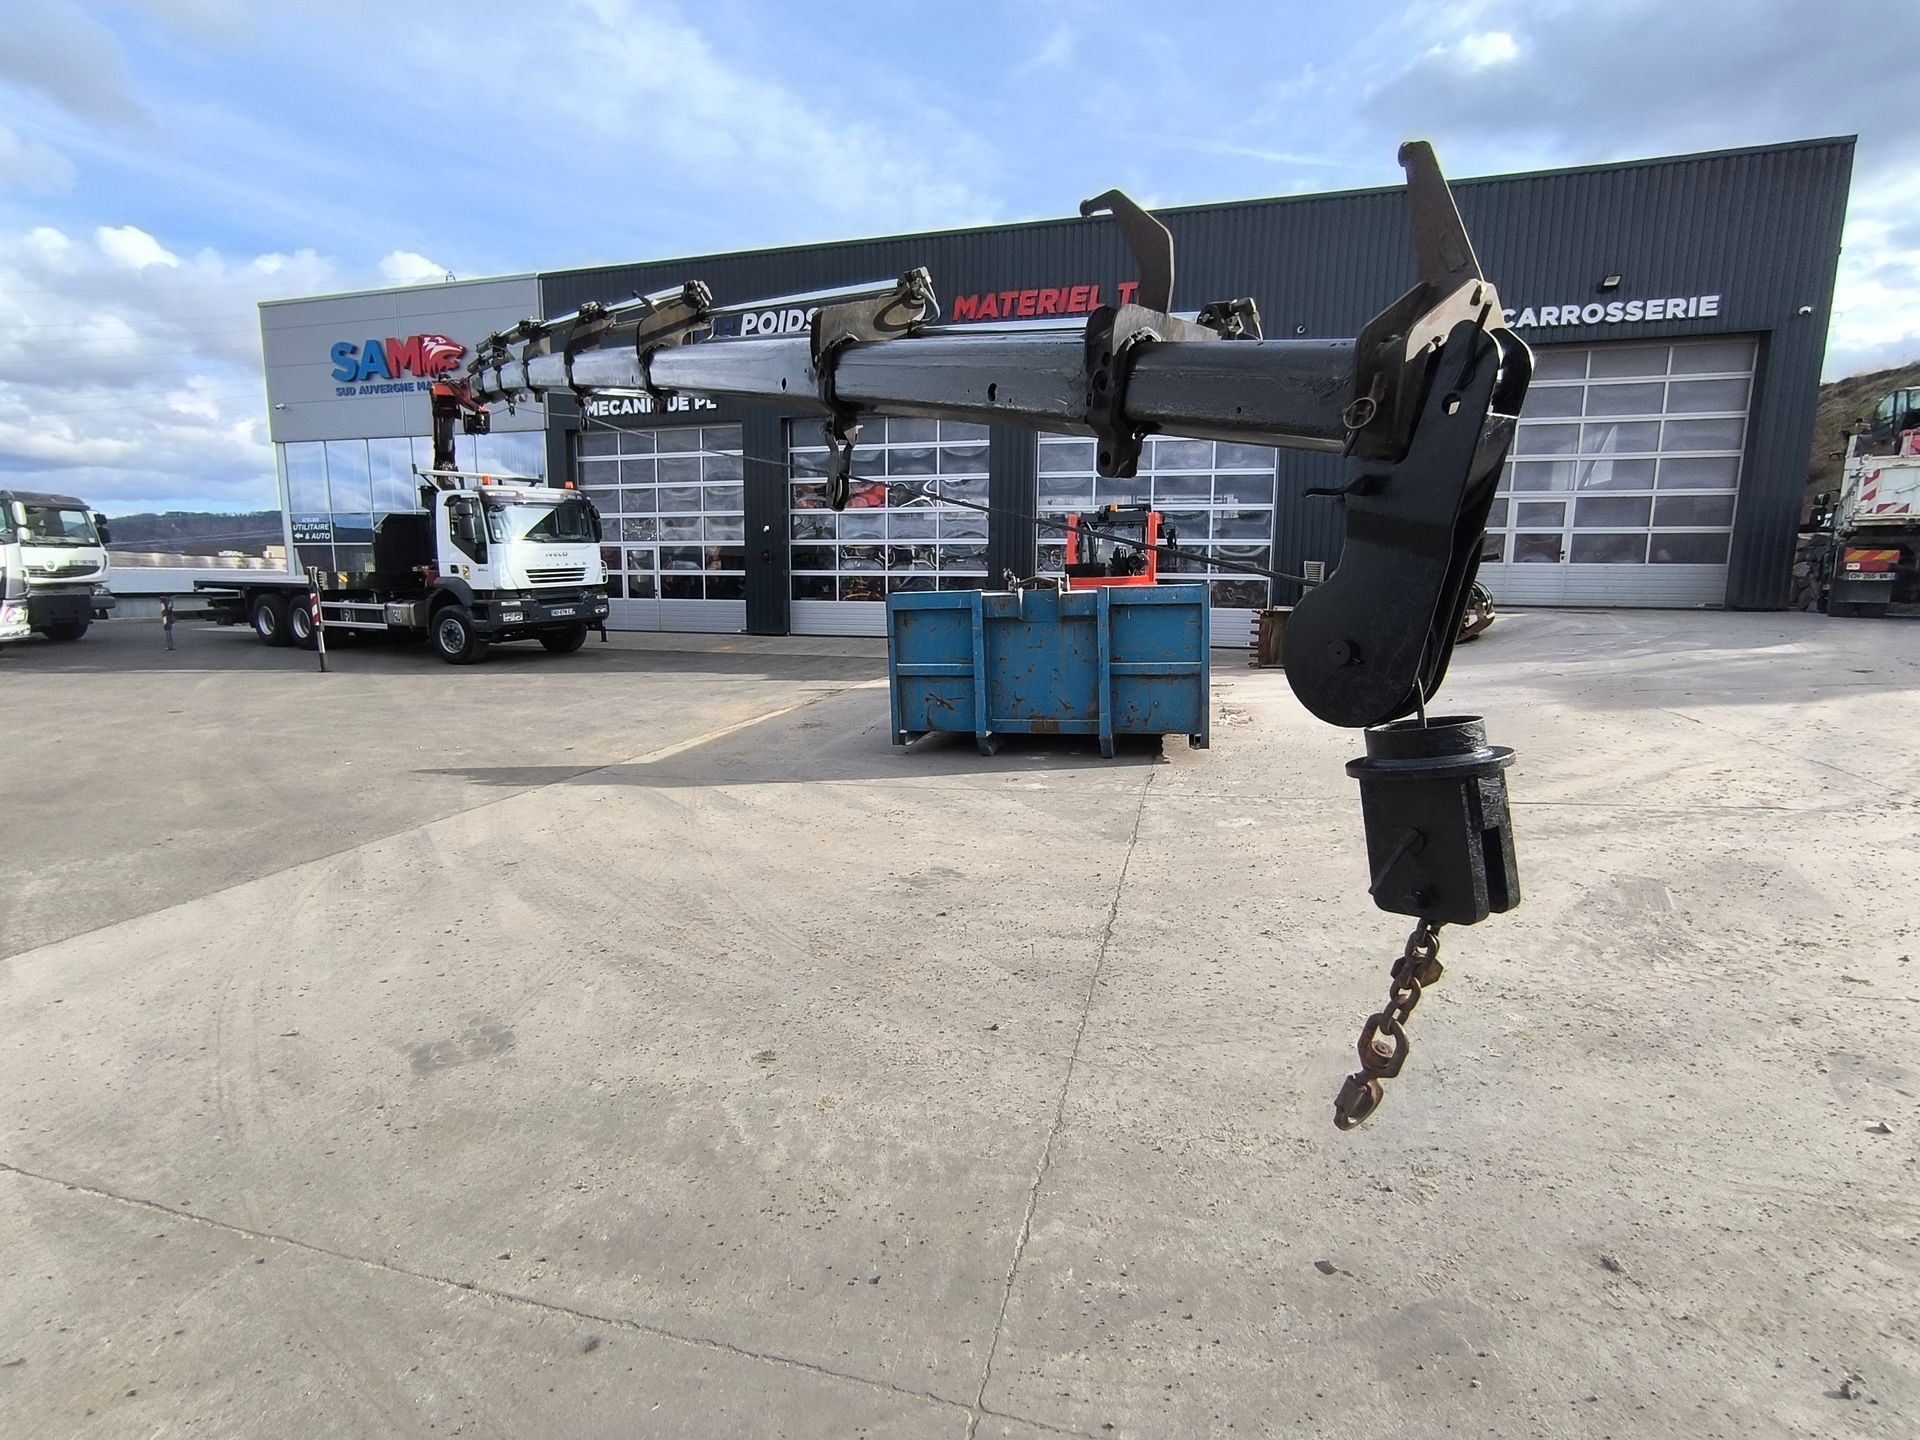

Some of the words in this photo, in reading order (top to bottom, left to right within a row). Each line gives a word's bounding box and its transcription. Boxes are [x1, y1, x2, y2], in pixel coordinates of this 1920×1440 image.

[953, 284, 1105, 321] MATERIEL
[1502, 295, 1720, 328] CARROSSERIE
[330, 335, 423, 382] SAM
[336, 387, 356, 397] SUD
[359, 383, 415, 394] AUVERGNE
[585, 396, 689, 417] MECANIUE
[293, 523, 329, 531] UTILITAIRE
[311, 532, 331, 540] AUTO
